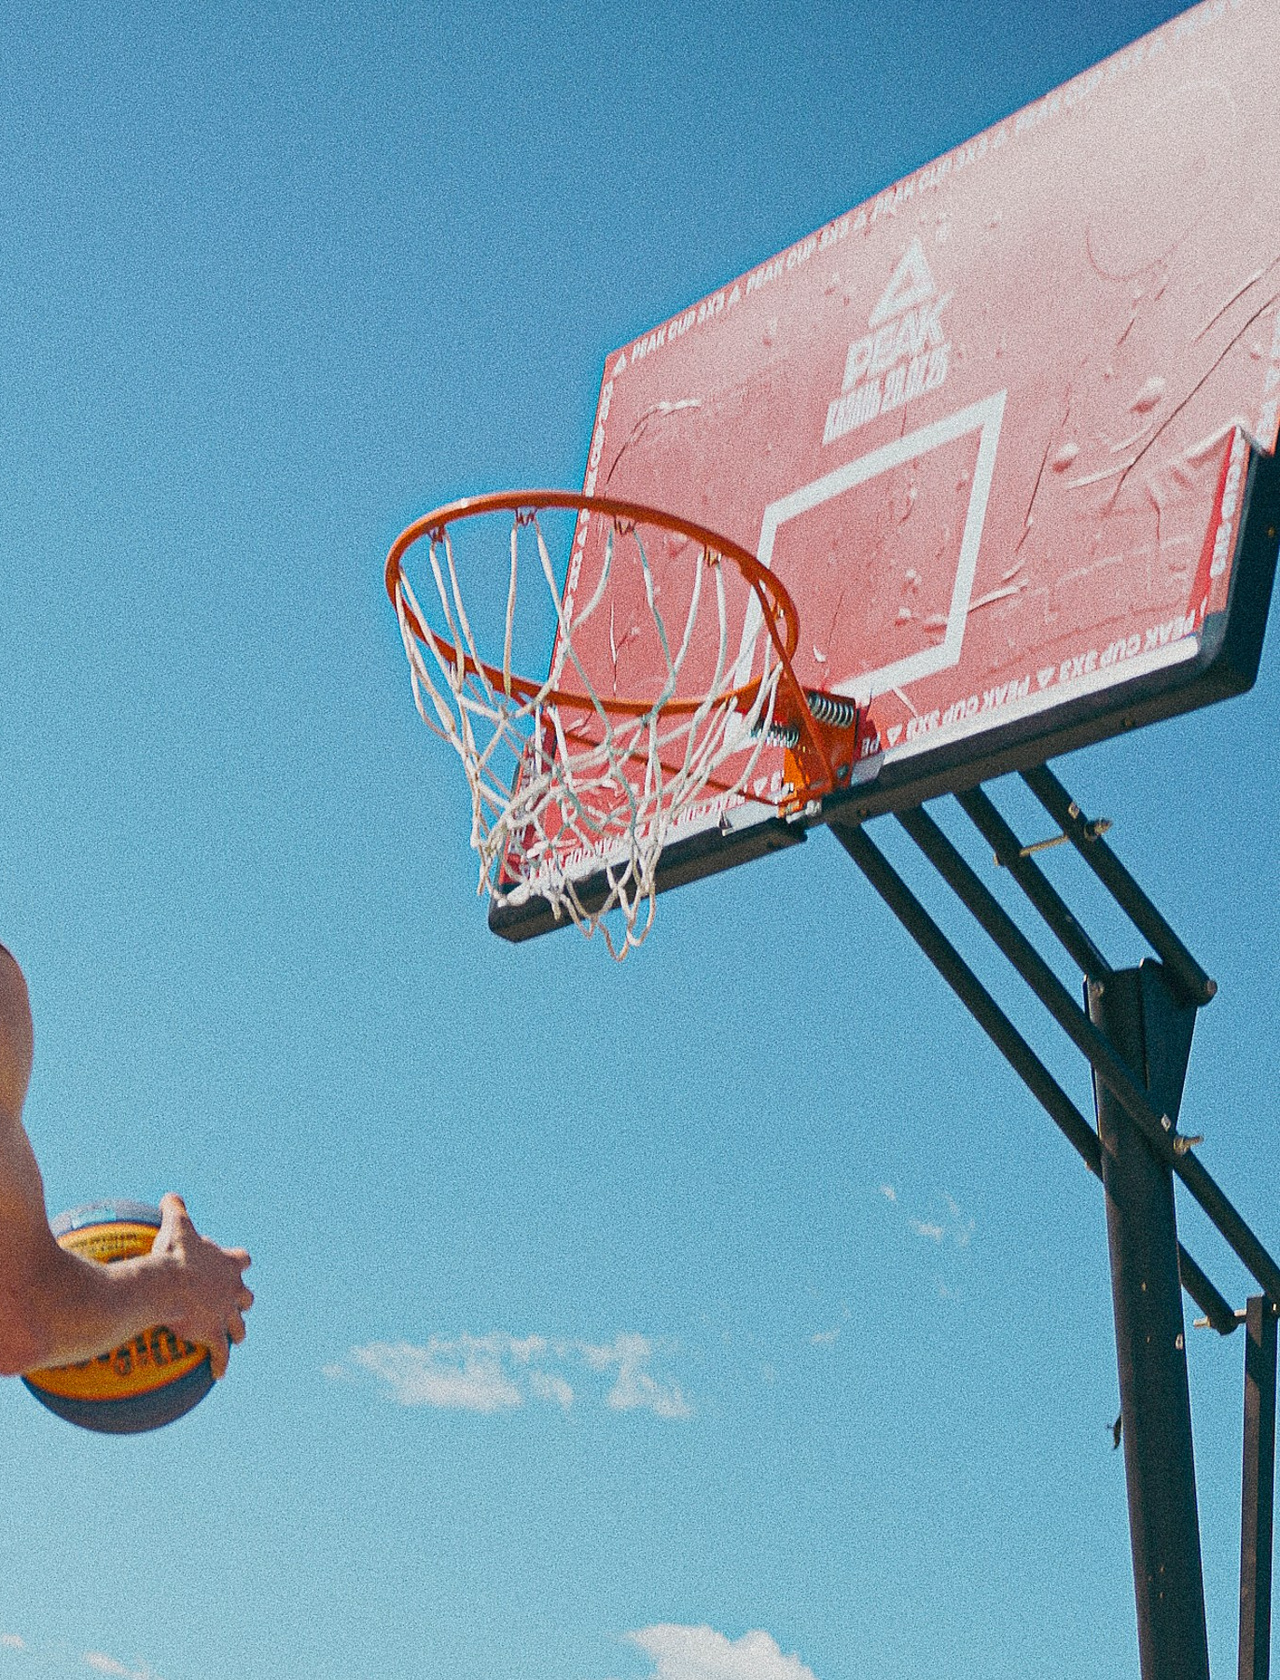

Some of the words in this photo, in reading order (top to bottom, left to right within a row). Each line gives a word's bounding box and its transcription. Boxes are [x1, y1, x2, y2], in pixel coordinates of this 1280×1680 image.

[668, 310, 696, 342] CUP
[786, 237, 817, 271] CUP
[841, 288, 954, 393] PEAK
[1145, 609, 1196, 651] PEAK
[1058, 650, 1098, 683] 3X3
[1100, 633, 1142, 669] CUP
[942, 694, 978, 725] CUP
[977, 675, 1031, 709] PEAK
